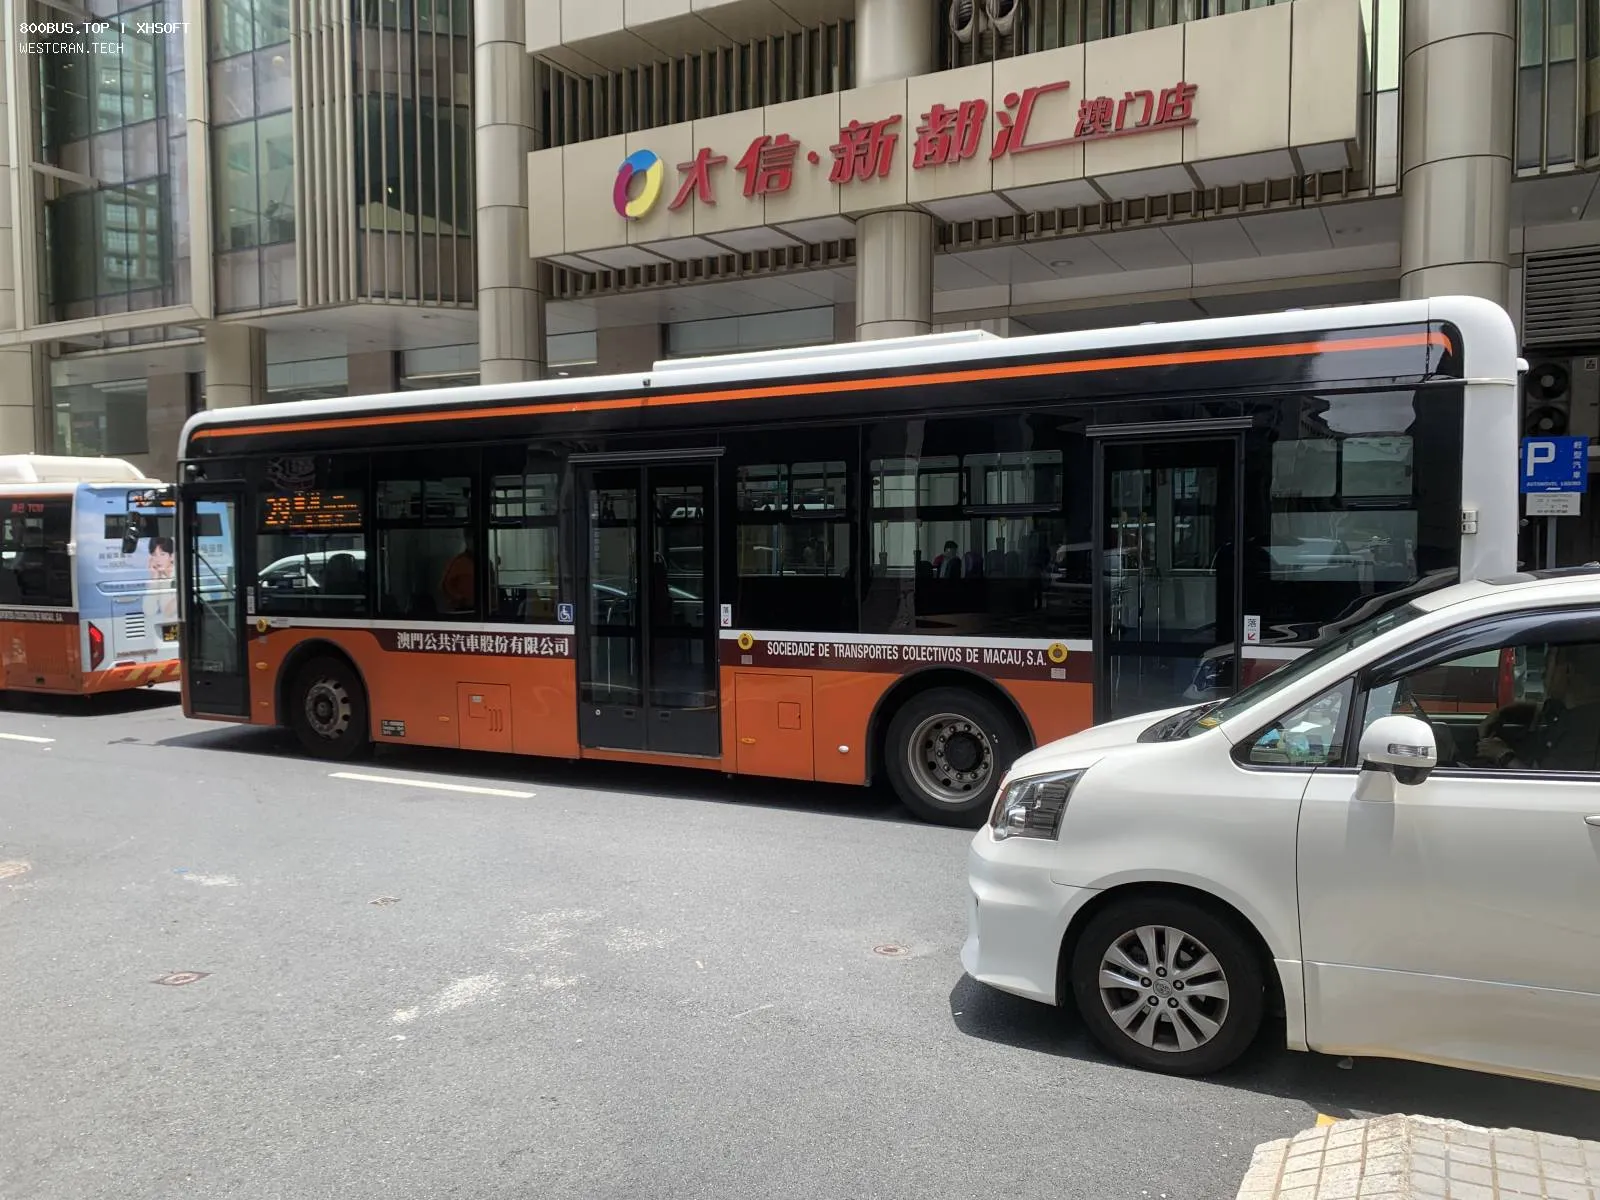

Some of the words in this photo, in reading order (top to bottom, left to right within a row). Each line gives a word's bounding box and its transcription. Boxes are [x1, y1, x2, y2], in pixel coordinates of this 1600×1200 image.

[1074, 81, 1199, 138] 澳门店
[1526, 441, 1556, 477] P
[397, 632, 569, 656] 澳門公共汽車股份有限公司
[767, 641, 815, 657] SOCIEDADE
[818, 643, 830, 658] DE
[833, 643, 899, 660] TRANSPORTES
[902, 645, 962, 662] COLECTIVOS
[966, 648, 979, 663] DE
[983, 649, 1025, 667] MACAU,
[1026, 650, 1047, 666] S.A.
